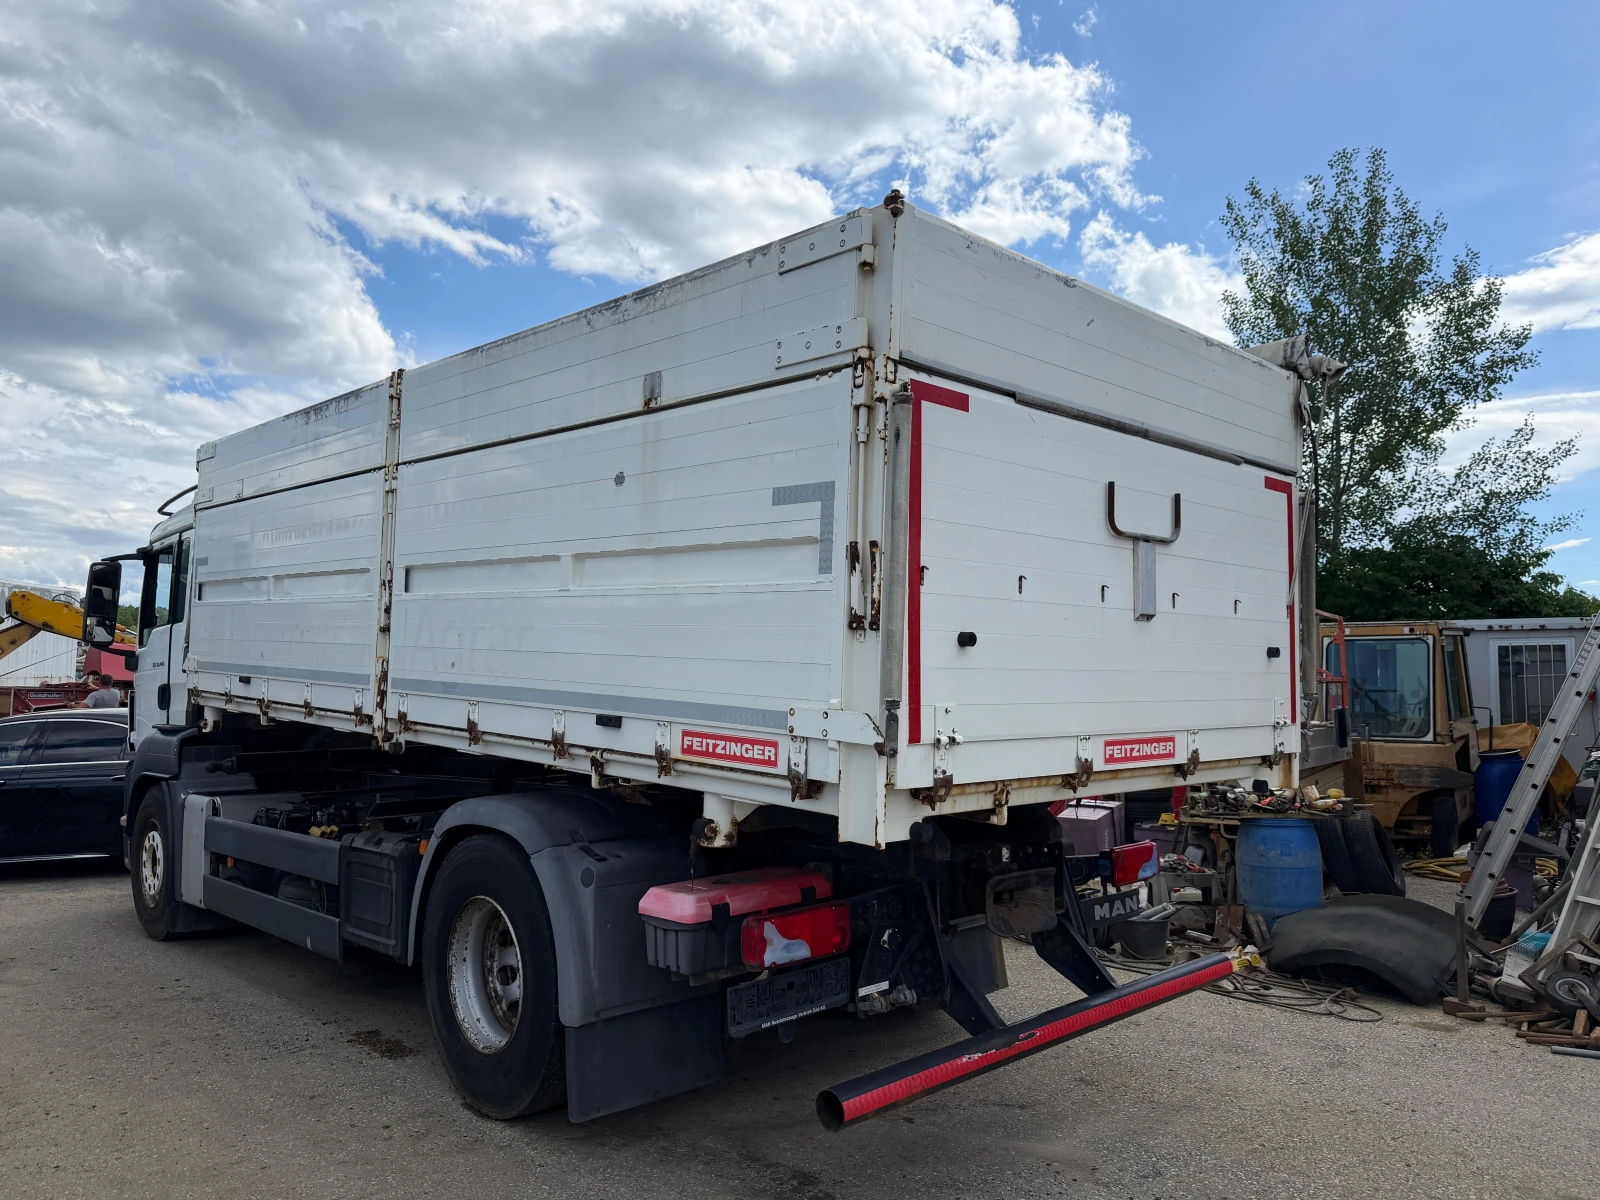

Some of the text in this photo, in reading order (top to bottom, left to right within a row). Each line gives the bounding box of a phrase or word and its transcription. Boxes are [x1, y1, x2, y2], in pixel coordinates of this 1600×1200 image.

[683, 737, 776, 761] FEITZINGER
[1106, 741, 1174, 758] FEITZINGER
[1094, 895, 1138, 920] MAN
[761, 1021, 771, 1029] MAN
